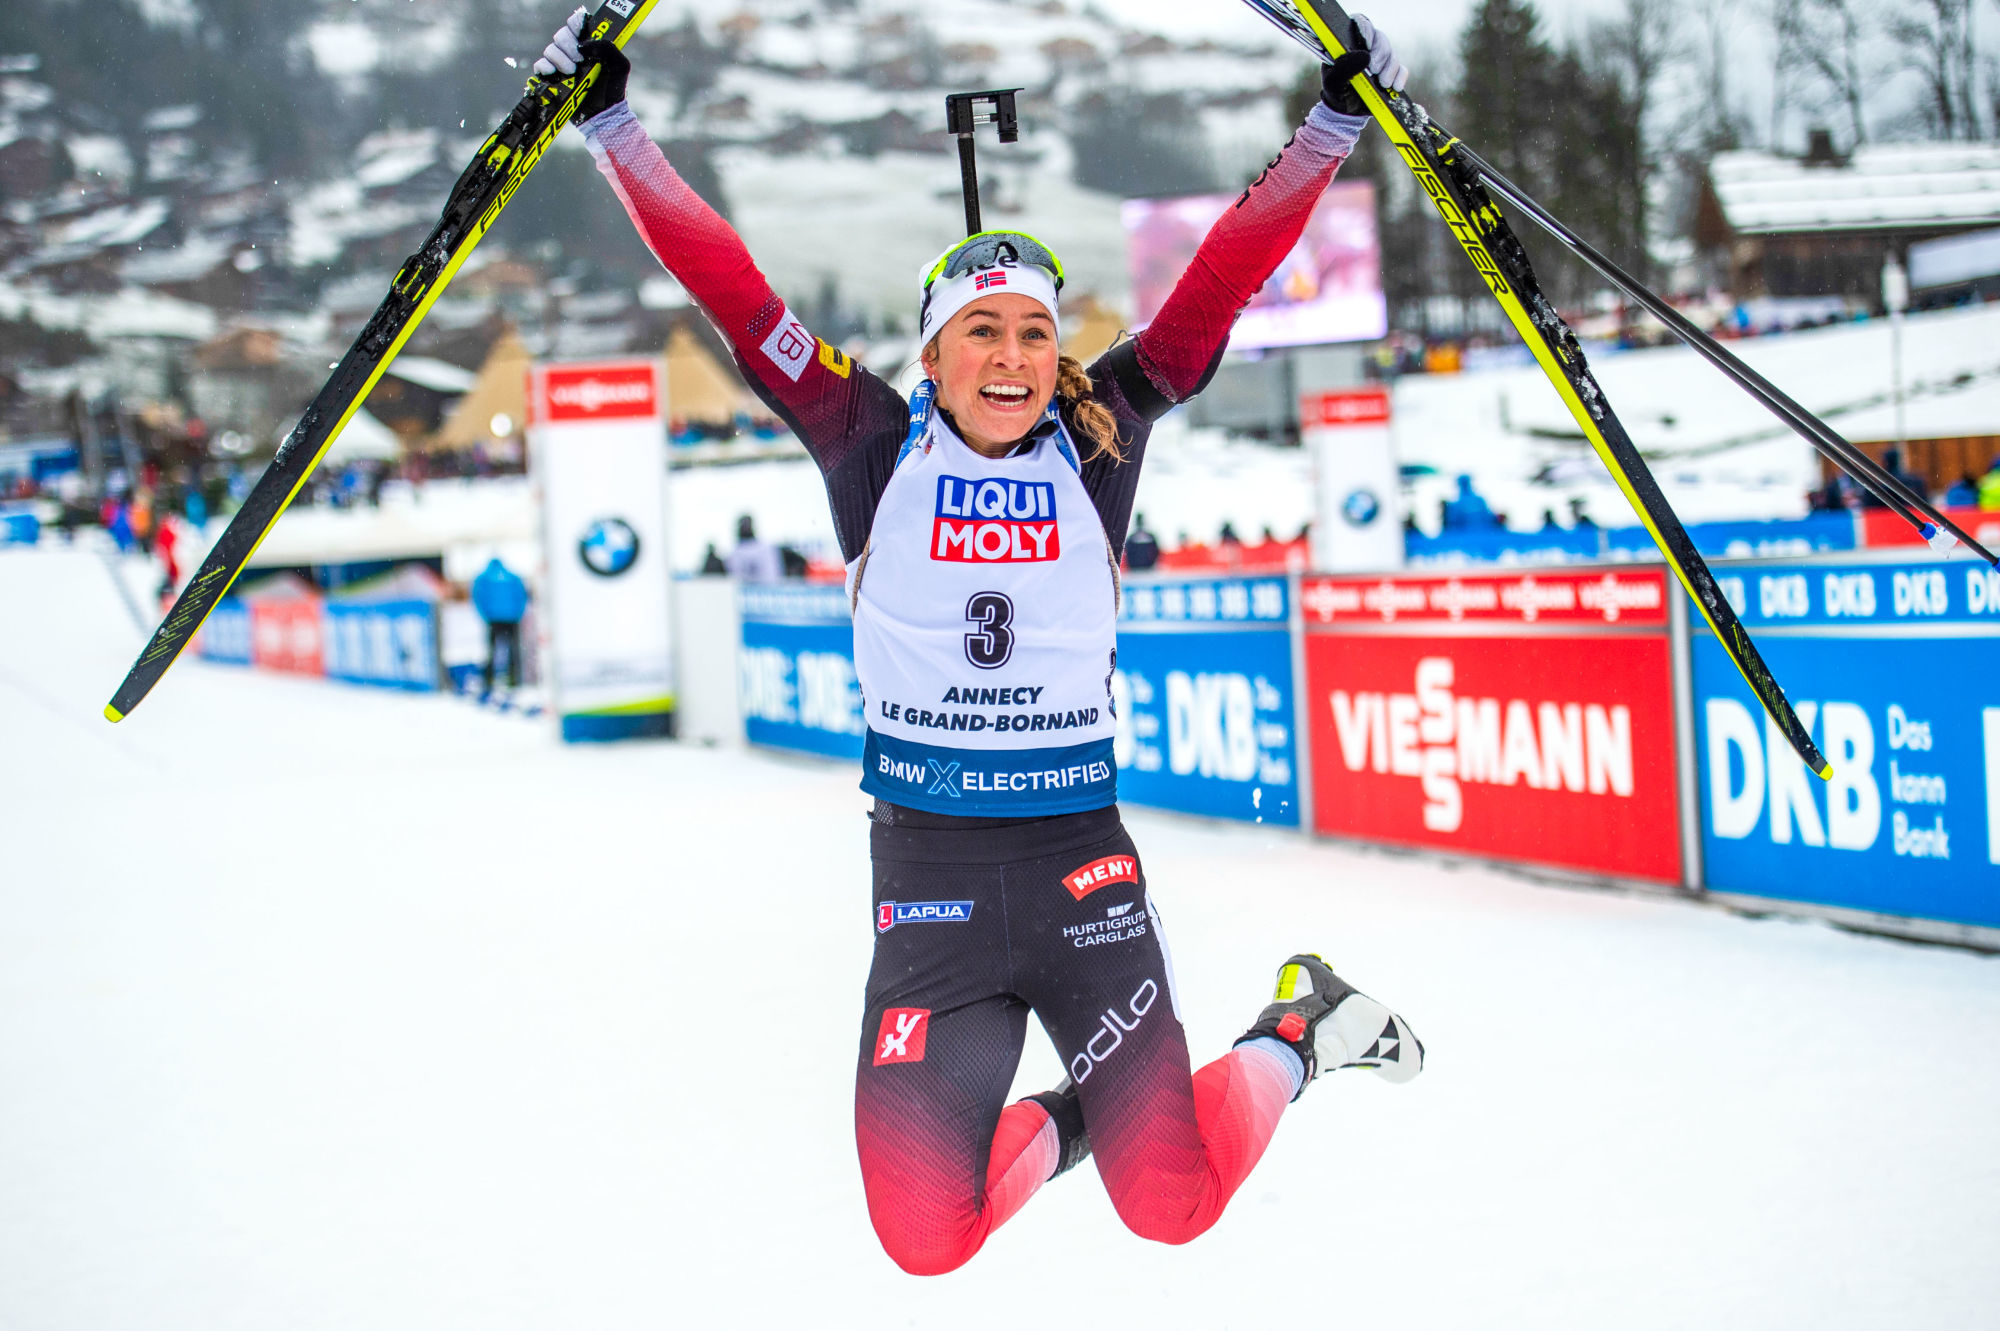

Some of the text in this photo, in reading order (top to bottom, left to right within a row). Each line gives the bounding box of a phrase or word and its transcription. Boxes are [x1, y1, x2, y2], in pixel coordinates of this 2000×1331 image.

[480, 78, 591, 233] FISCHER
[1395, 143, 1508, 294] FISCHER
[942, 480, 1050, 518] LIQUI
[937, 522, 1055, 560] MOLY
[1894, 570, 1947, 616] DKB
[1967, 569, 2000, 615] DK
[964, 591, 1015, 670] 3
[881, 701, 1099, 732] LE GRAND-BORNAND
[942, 687, 1043, 705] ANNECY
[1331, 657, 1633, 833] VIESSMANN
[1888, 704, 1932, 750] Das
[879, 753, 1110, 797] BMW X ELECTRIFIED
[1706, 697, 1881, 851] DKB
[1891, 760, 1946, 804] kann
[1893, 811, 1949, 860] Bank
[1073, 860, 1133, 891] MENY
[897, 905, 964, 919] LAPUA
[1073, 925, 1146, 948] CARGLASS
[1071, 979, 1158, 1084] odlo
